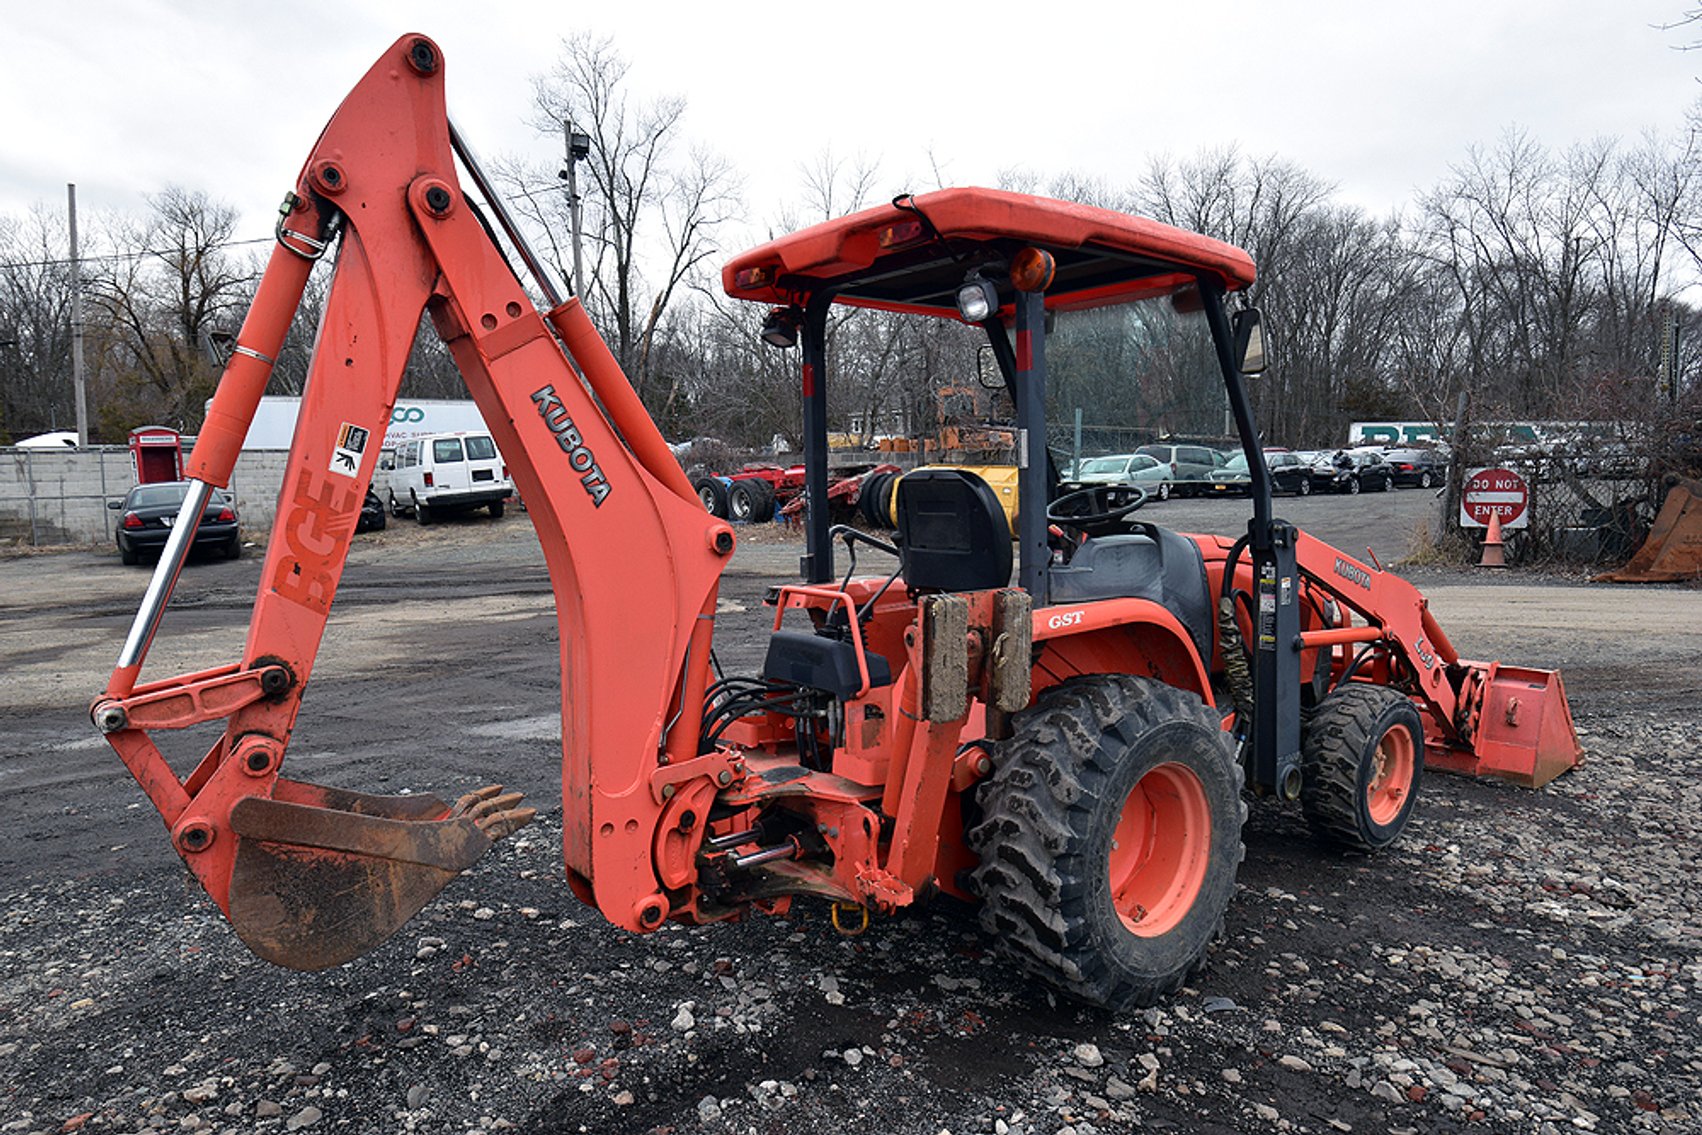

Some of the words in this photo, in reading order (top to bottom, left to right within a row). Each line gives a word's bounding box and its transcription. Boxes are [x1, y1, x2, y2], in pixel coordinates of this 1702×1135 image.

[389, 407, 425, 424] CO
[530, 384, 612, 509] KUBOTA
[1473, 480, 1490, 490] DO
[1496, 480, 1519, 490] NOT
[1475, 505, 1513, 516] ENTER
[272, 468, 358, 616] BGE
[1333, 557, 1372, 592] KUBOTA
[1048, 611, 1085, 629] GST
